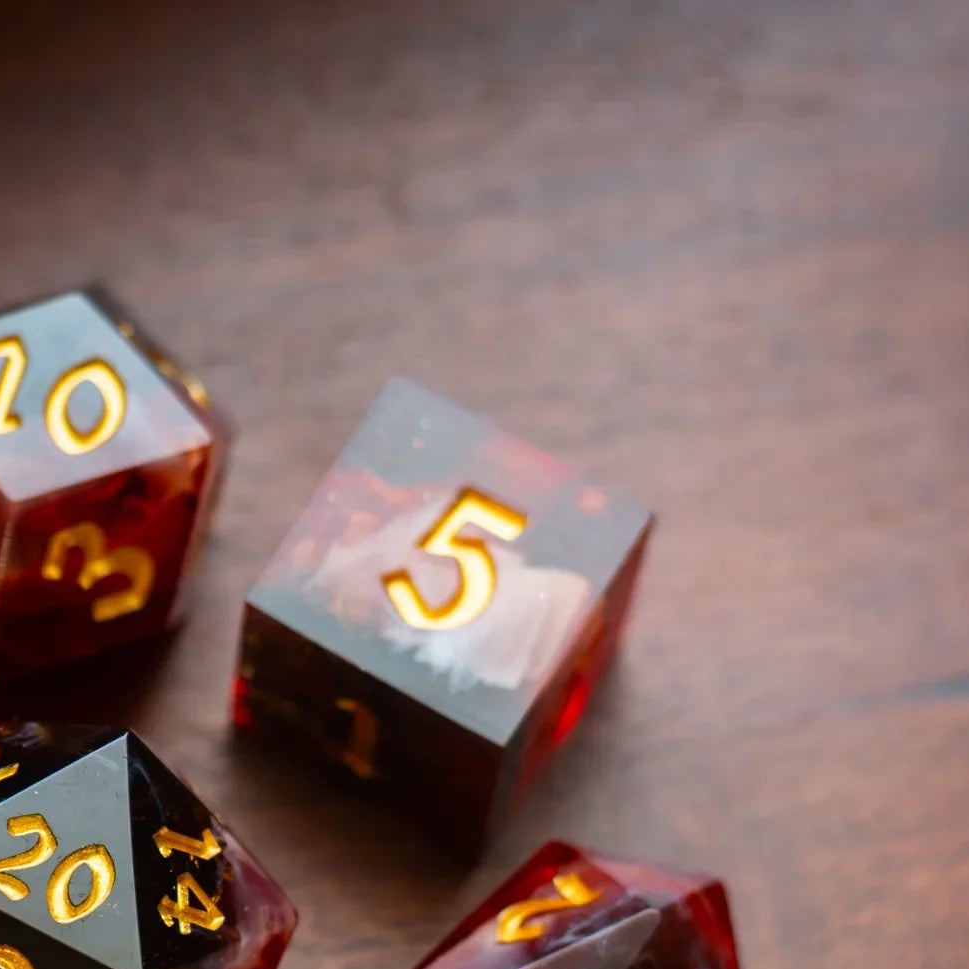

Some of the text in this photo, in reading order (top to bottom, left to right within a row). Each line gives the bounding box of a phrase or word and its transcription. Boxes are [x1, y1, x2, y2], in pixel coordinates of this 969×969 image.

[380, 483, 529, 631] 5
[152, 825, 226, 936] 14
[496, 873, 604, 944] 2
